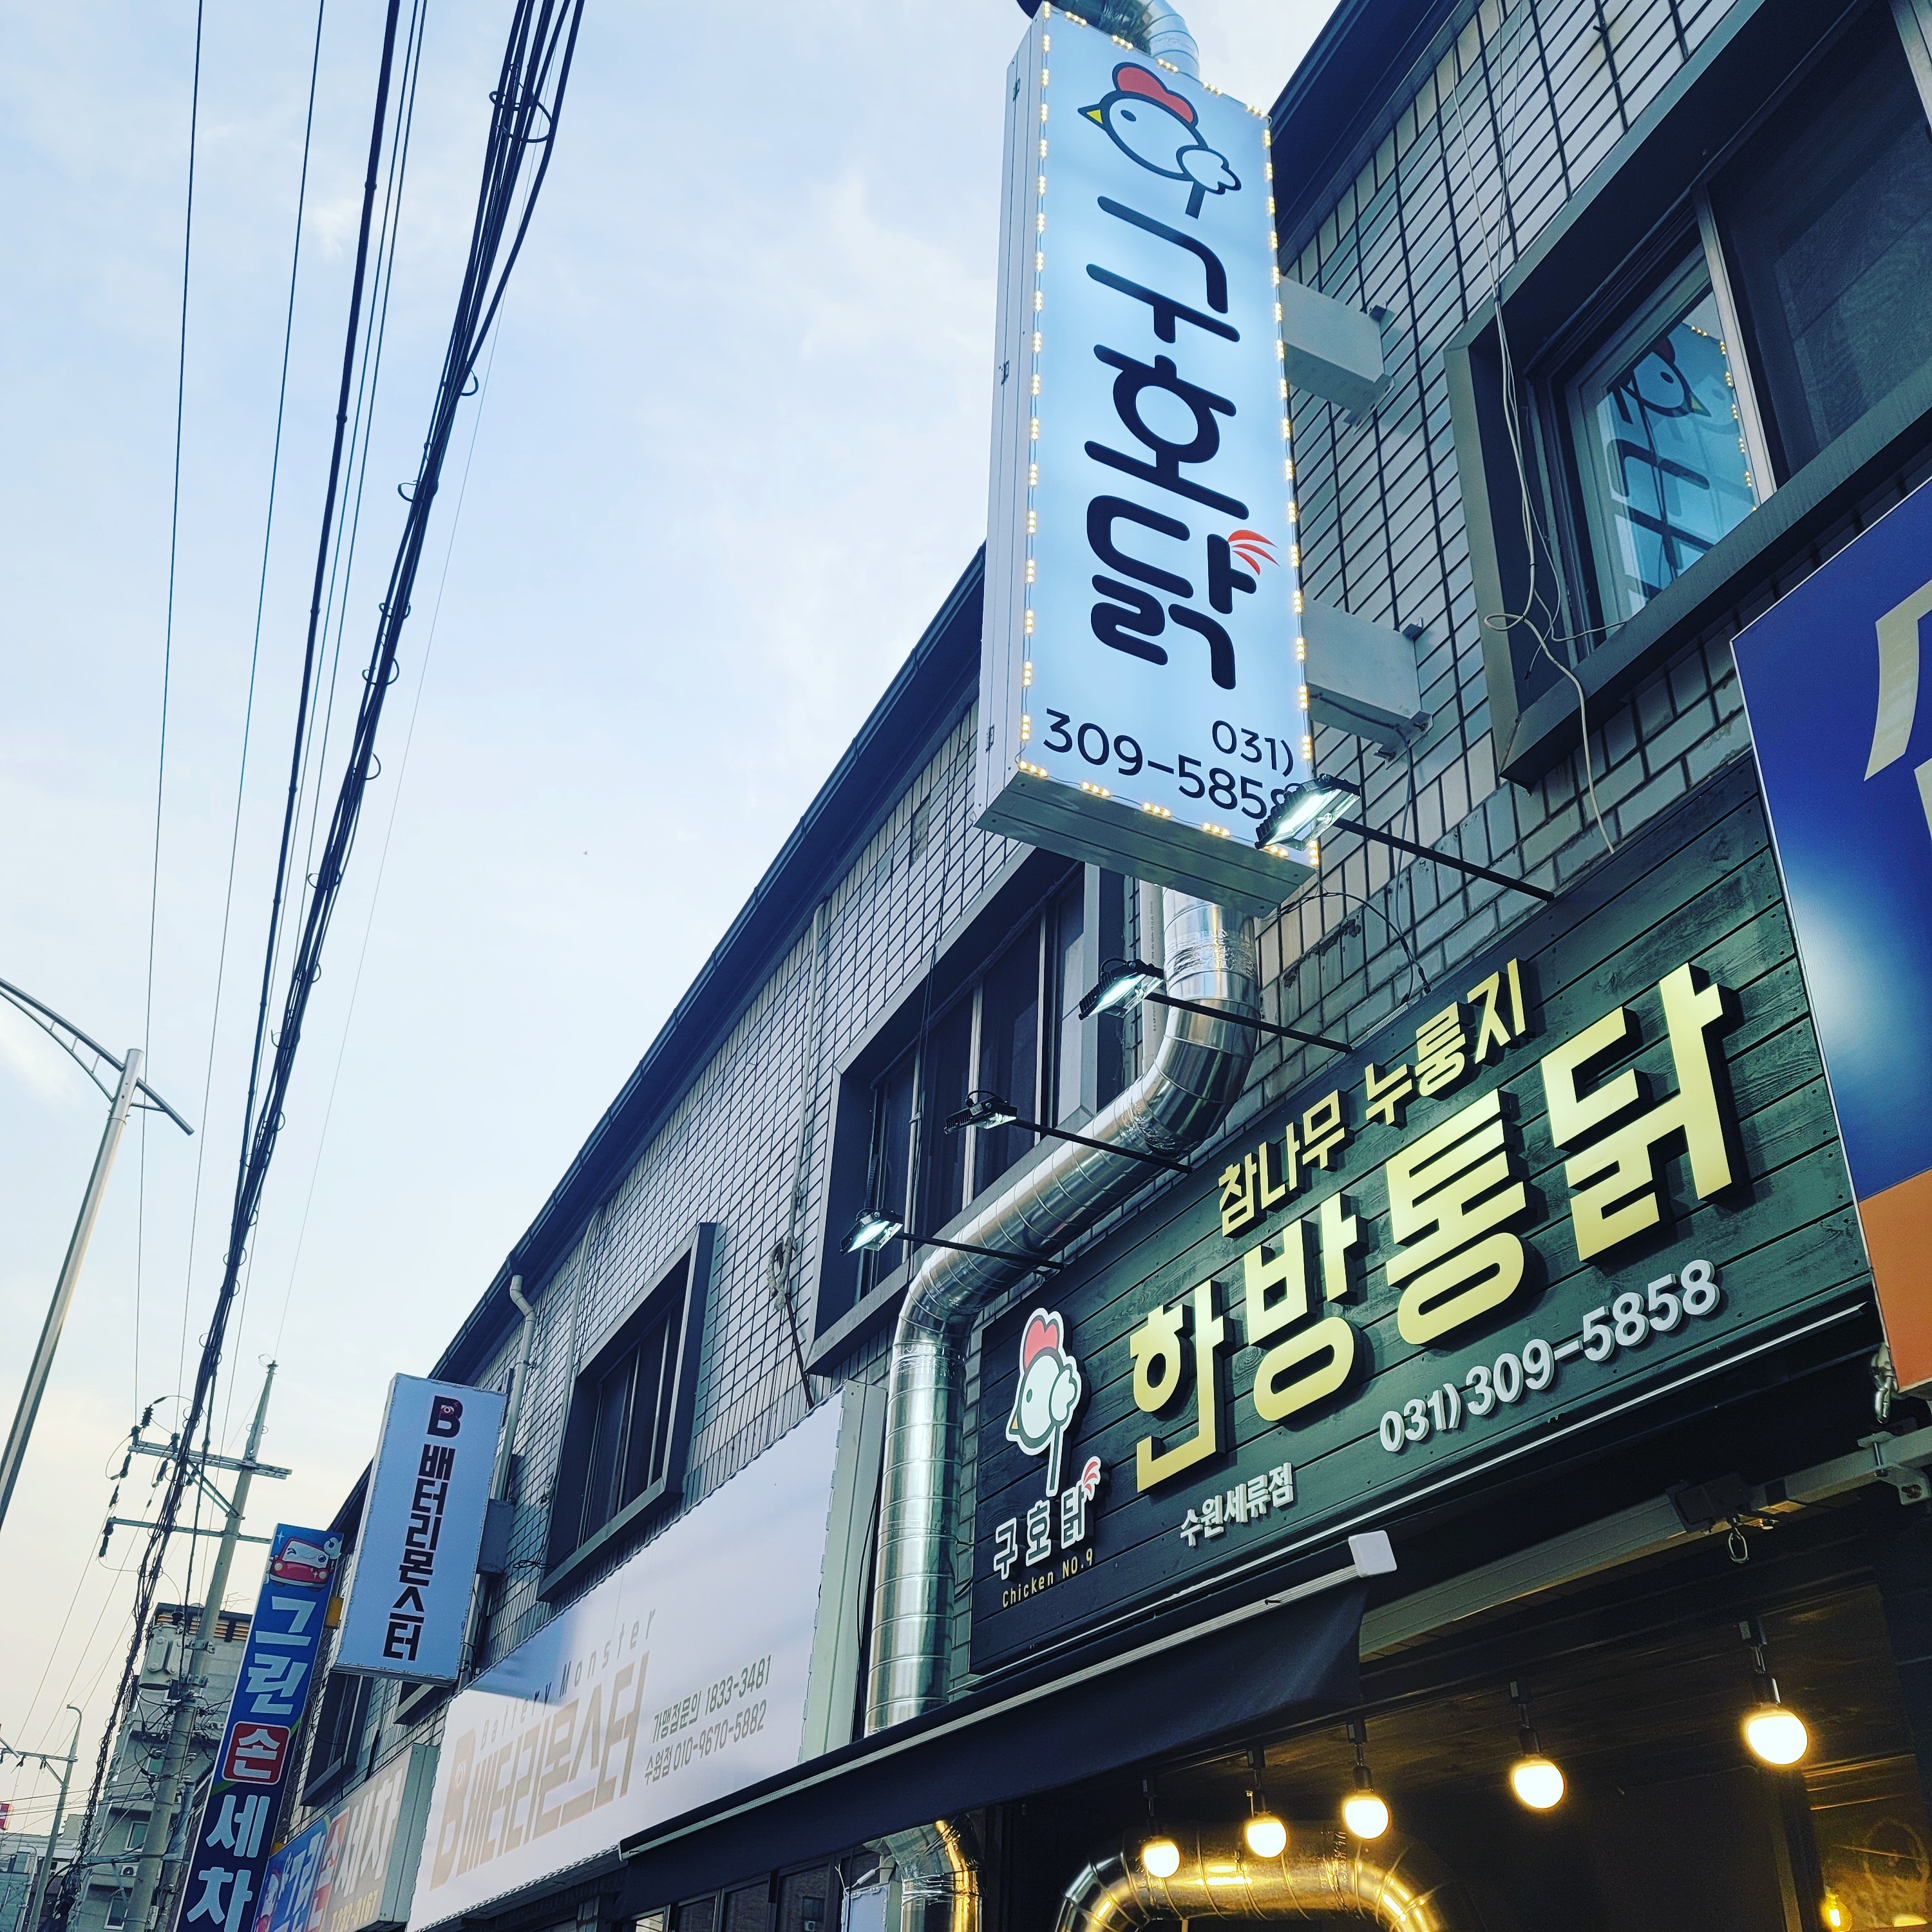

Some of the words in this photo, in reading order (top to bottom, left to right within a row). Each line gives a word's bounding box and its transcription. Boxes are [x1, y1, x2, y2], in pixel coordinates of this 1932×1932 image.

[1084, 196, 1256, 690] 구호닭
[1212, 720, 1294, 777] 031)
[1218, 1088, 1346, 1238] 참나무
[1366, 957, 1528, 1126] 누룽지
[1130, 962, 1732, 1493] 한방통닭
[1379, 1383, 1461, 1452] 031)
[1466, 1259, 1719, 1416] 309-5858
[383, 1444, 455, 1661] 배터리몬스터
[1002, 1569, 1054, 1608] Chicken
[1063, 1548, 1094, 1580] NO.9
[1180, 1463, 1294, 1547] 수원세류점
[480, 1681, 552, 1750] Battery
[560, 1609, 656, 1698] Monster
[652, 1690, 701, 1743] 가맹점문의
[705, 1654, 772, 1716] 1833-3481
[674, 1700, 766, 1771] 010-9670-5882
[456, 1651, 650, 1877] 배터리몬스터
